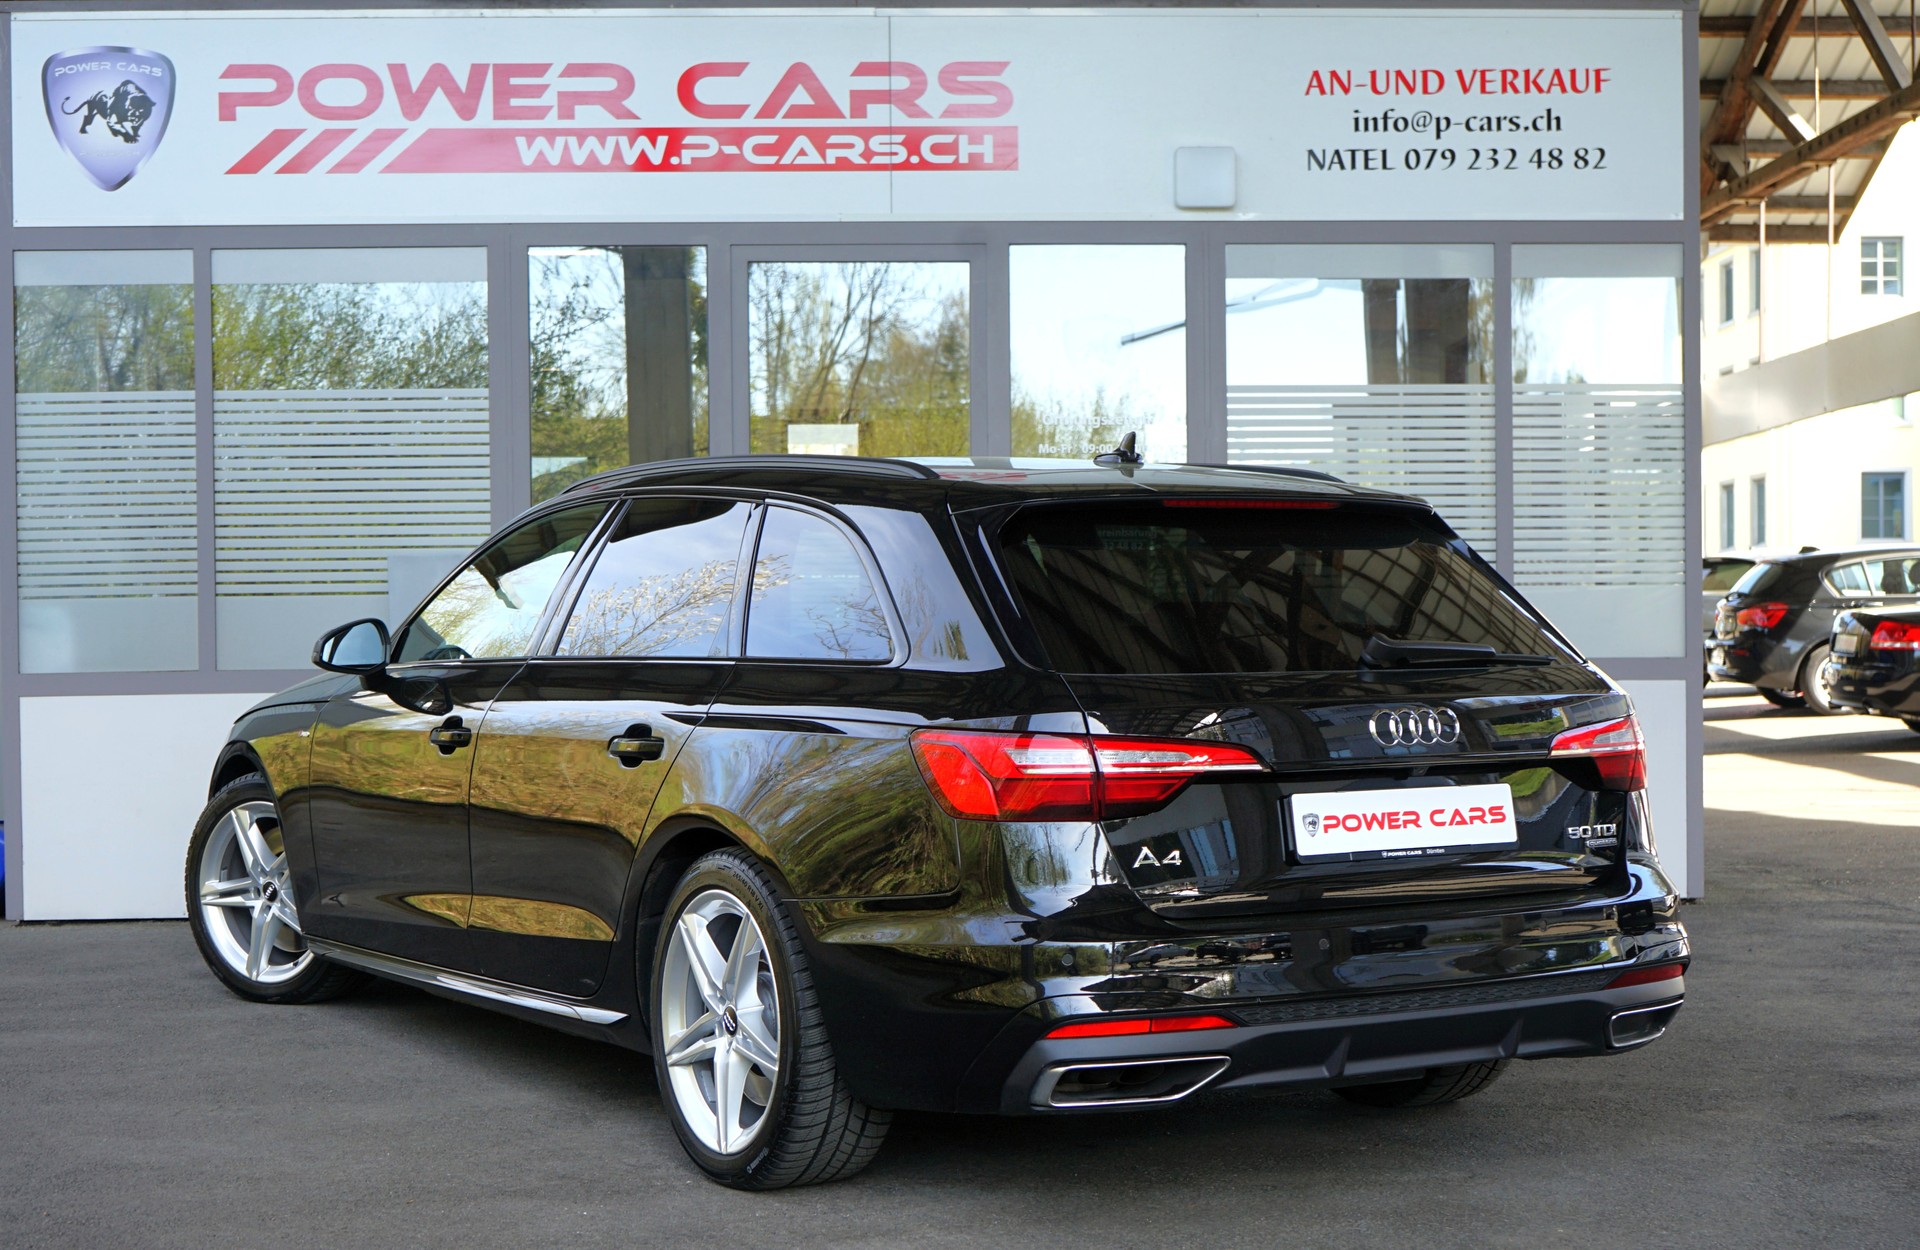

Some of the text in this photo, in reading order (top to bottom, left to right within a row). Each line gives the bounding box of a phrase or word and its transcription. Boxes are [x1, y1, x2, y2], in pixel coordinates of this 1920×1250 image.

[54, 61, 163, 77] POWER CARS
[1304, 67, 1612, 96] AN-UND VERKAUF
[218, 60, 1014, 121] POWER CARS
[1352, 108, 1563, 140] info@p-cars.ch
[515, 134, 994, 166] WWW.P-CARS.CH
[1306, 147, 1608, 171] NATEL 079 232 48 82
[1081, 443, 1114, 454] 09:00
[1323, 805, 1507, 834] POWER CARS
[1567, 823, 1617, 839] 50 TDI
[1132, 846, 1182, 868] A4
